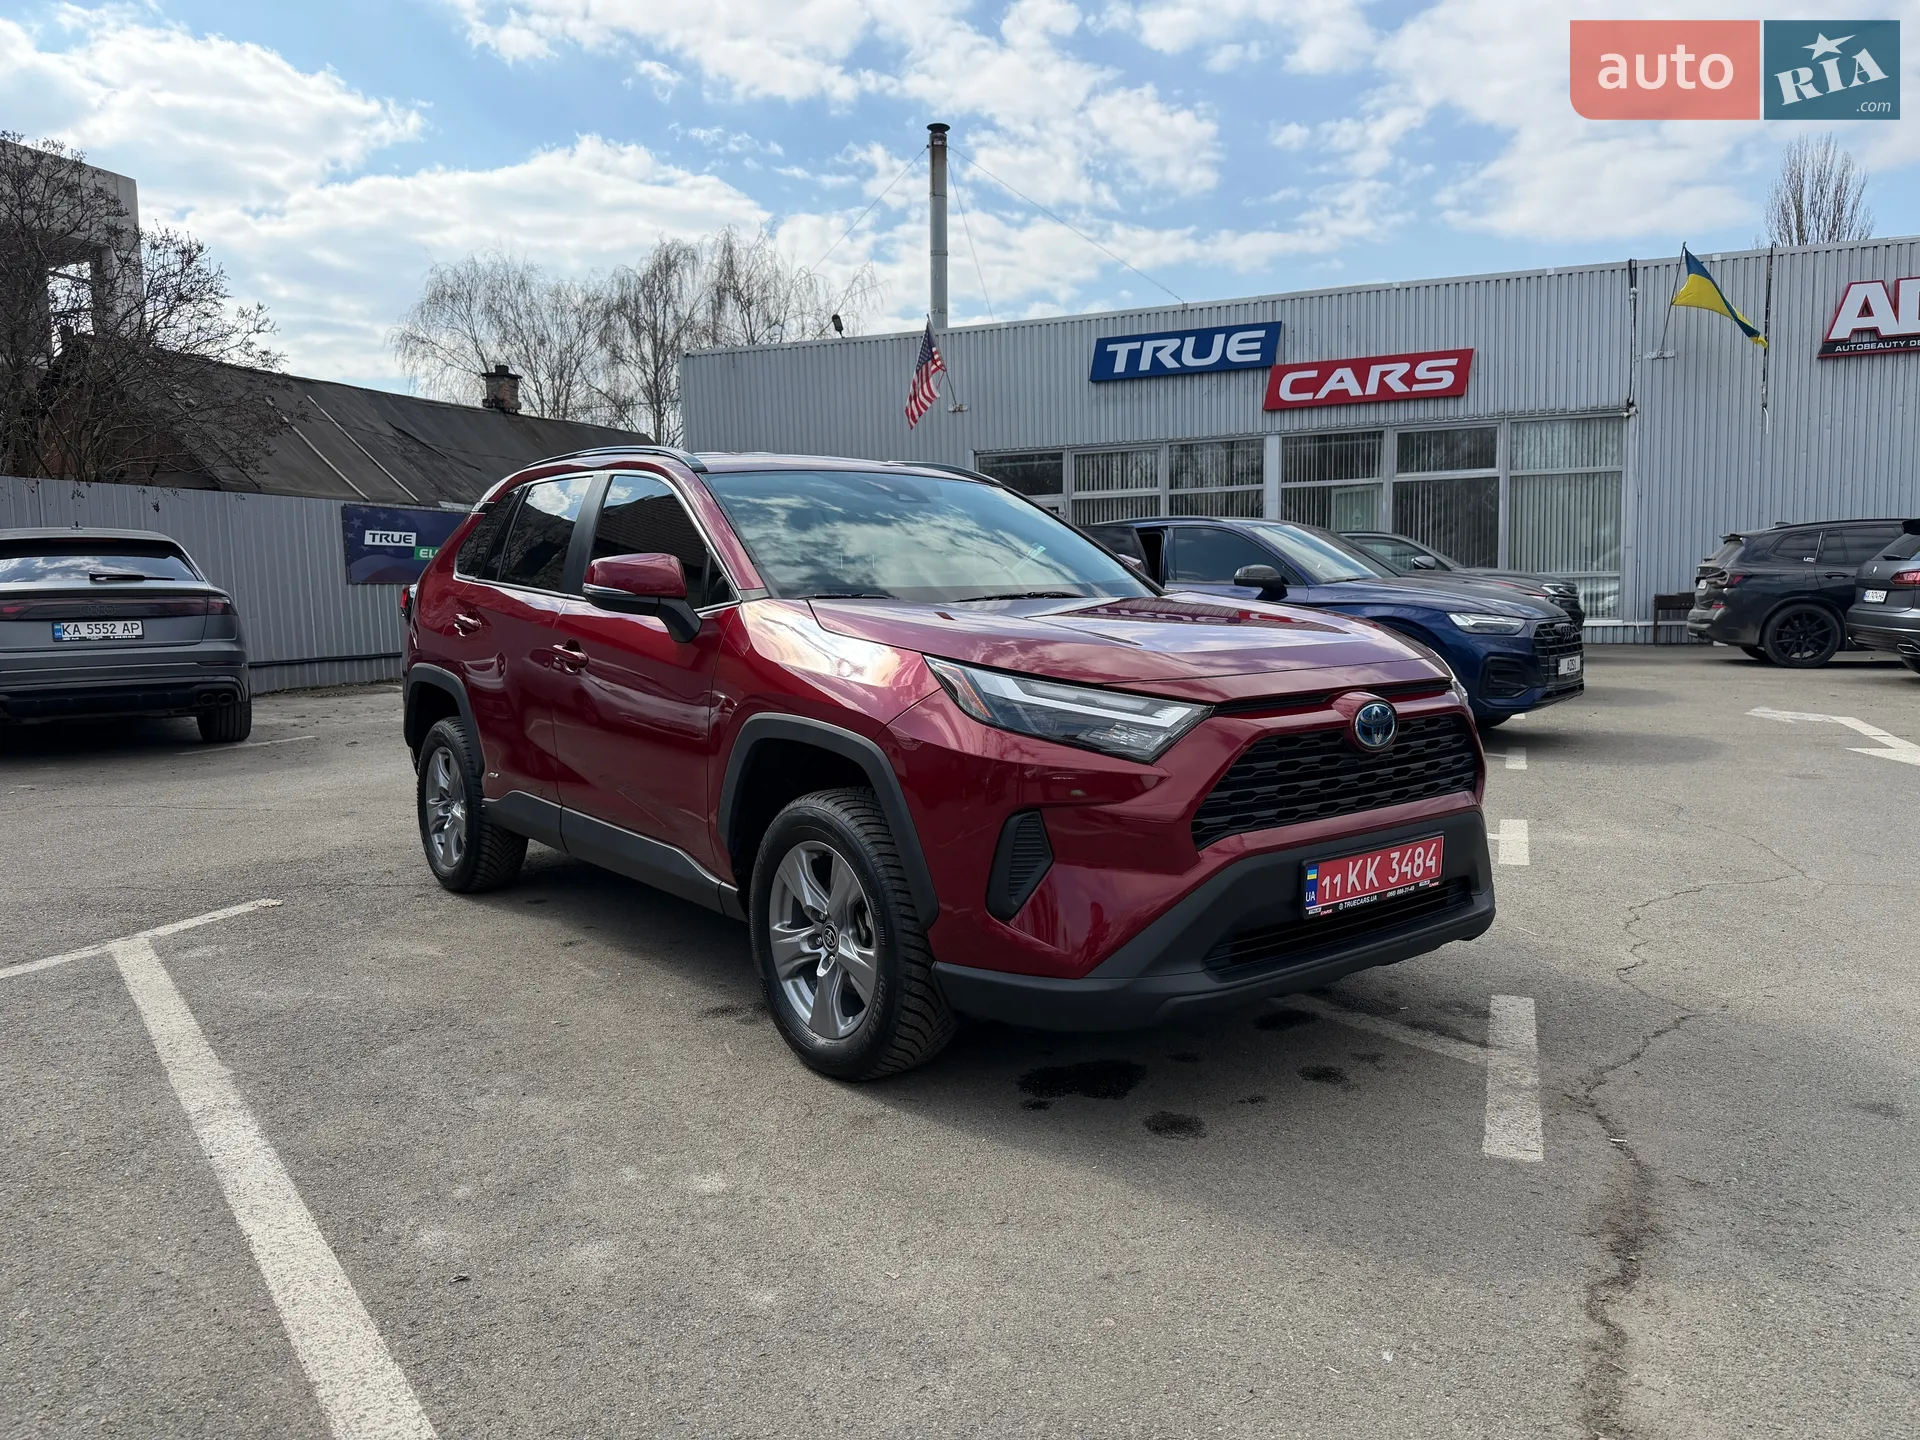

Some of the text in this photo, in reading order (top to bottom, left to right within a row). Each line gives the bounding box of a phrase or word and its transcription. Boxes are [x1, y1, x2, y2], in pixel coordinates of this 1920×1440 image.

[1105, 329, 1266, 374] TRUE
[1835, 340, 1906, 352] AUTOBEAUTY
[1278, 357, 1459, 402] CARS
[369, 532, 413, 545] TRUE
[62, 622, 140, 636] KA 5552 AP
[1321, 843, 1437, 900] 11 KK 3484
[1305, 890, 1316, 902] UA
